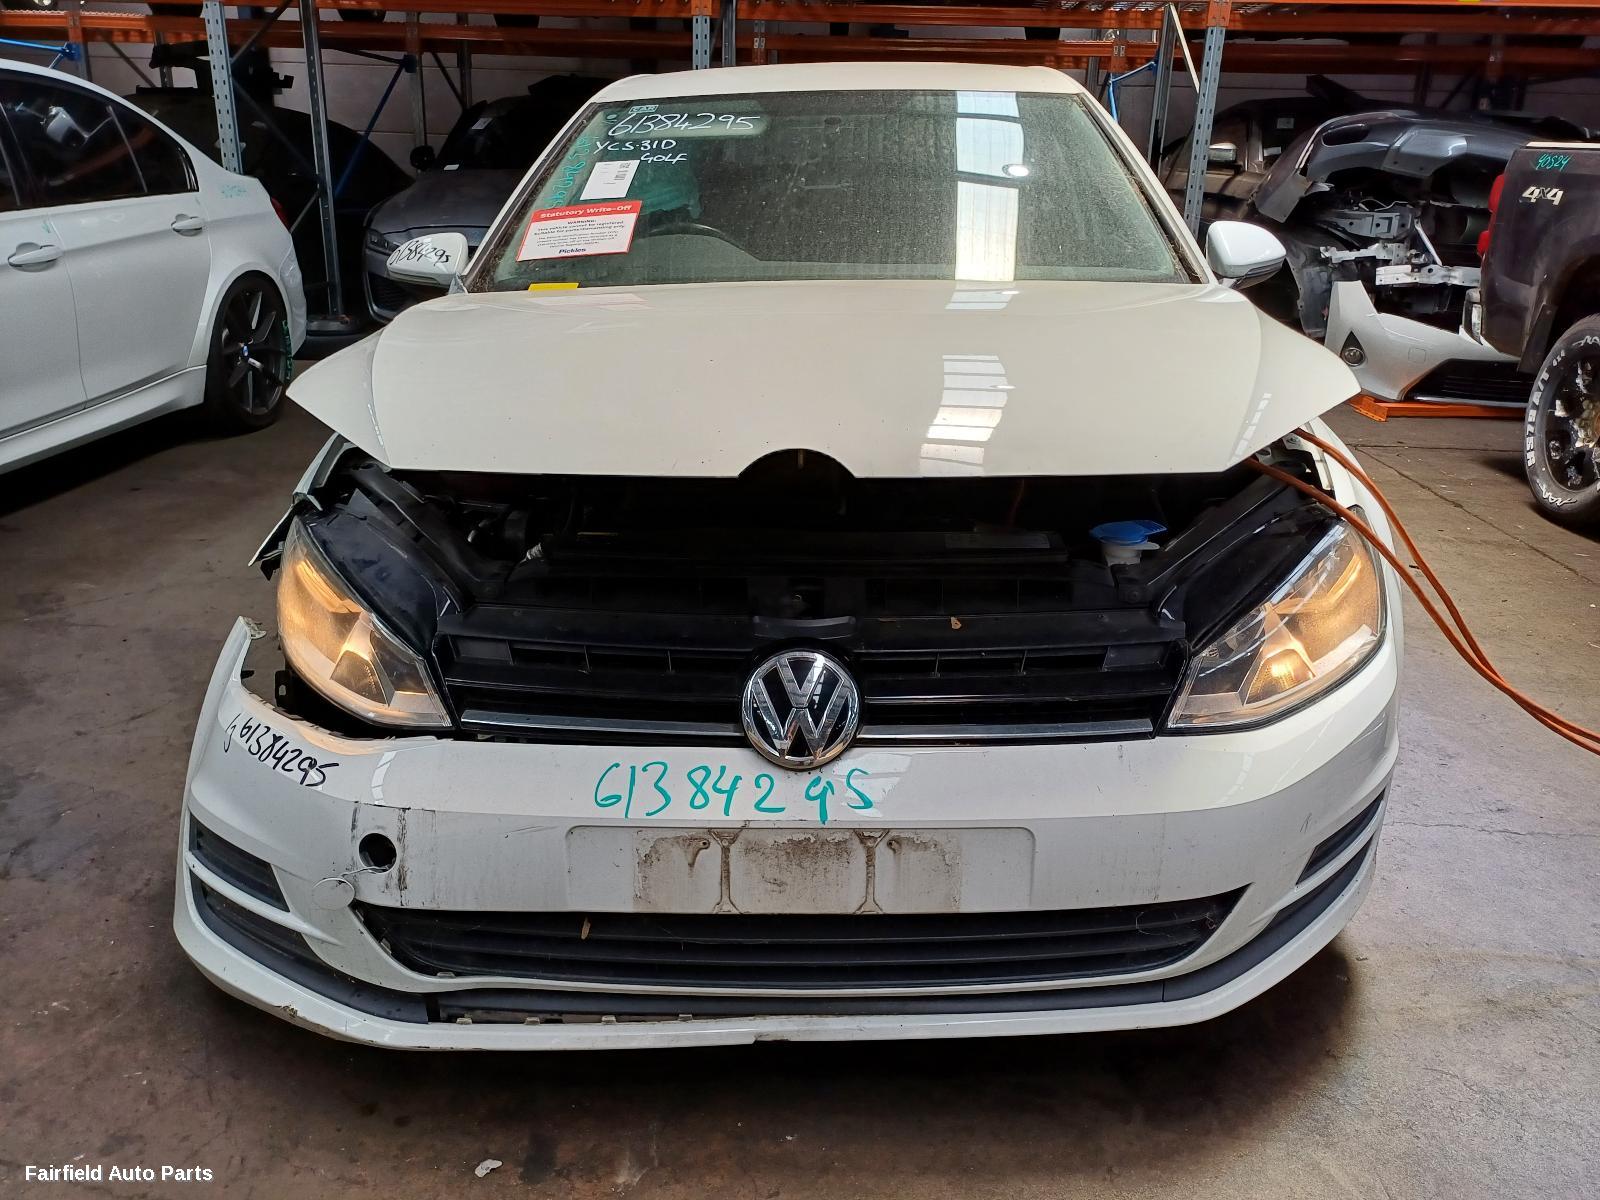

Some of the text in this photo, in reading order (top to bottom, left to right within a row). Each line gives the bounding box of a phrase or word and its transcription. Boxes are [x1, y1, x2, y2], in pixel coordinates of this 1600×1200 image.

[608, 112, 761, 136] 61384295
[640, 153, 688, 164] GOLF
[540, 205, 633, 218] Statutory Write-Off
[239, 716, 340, 787] 61384295
